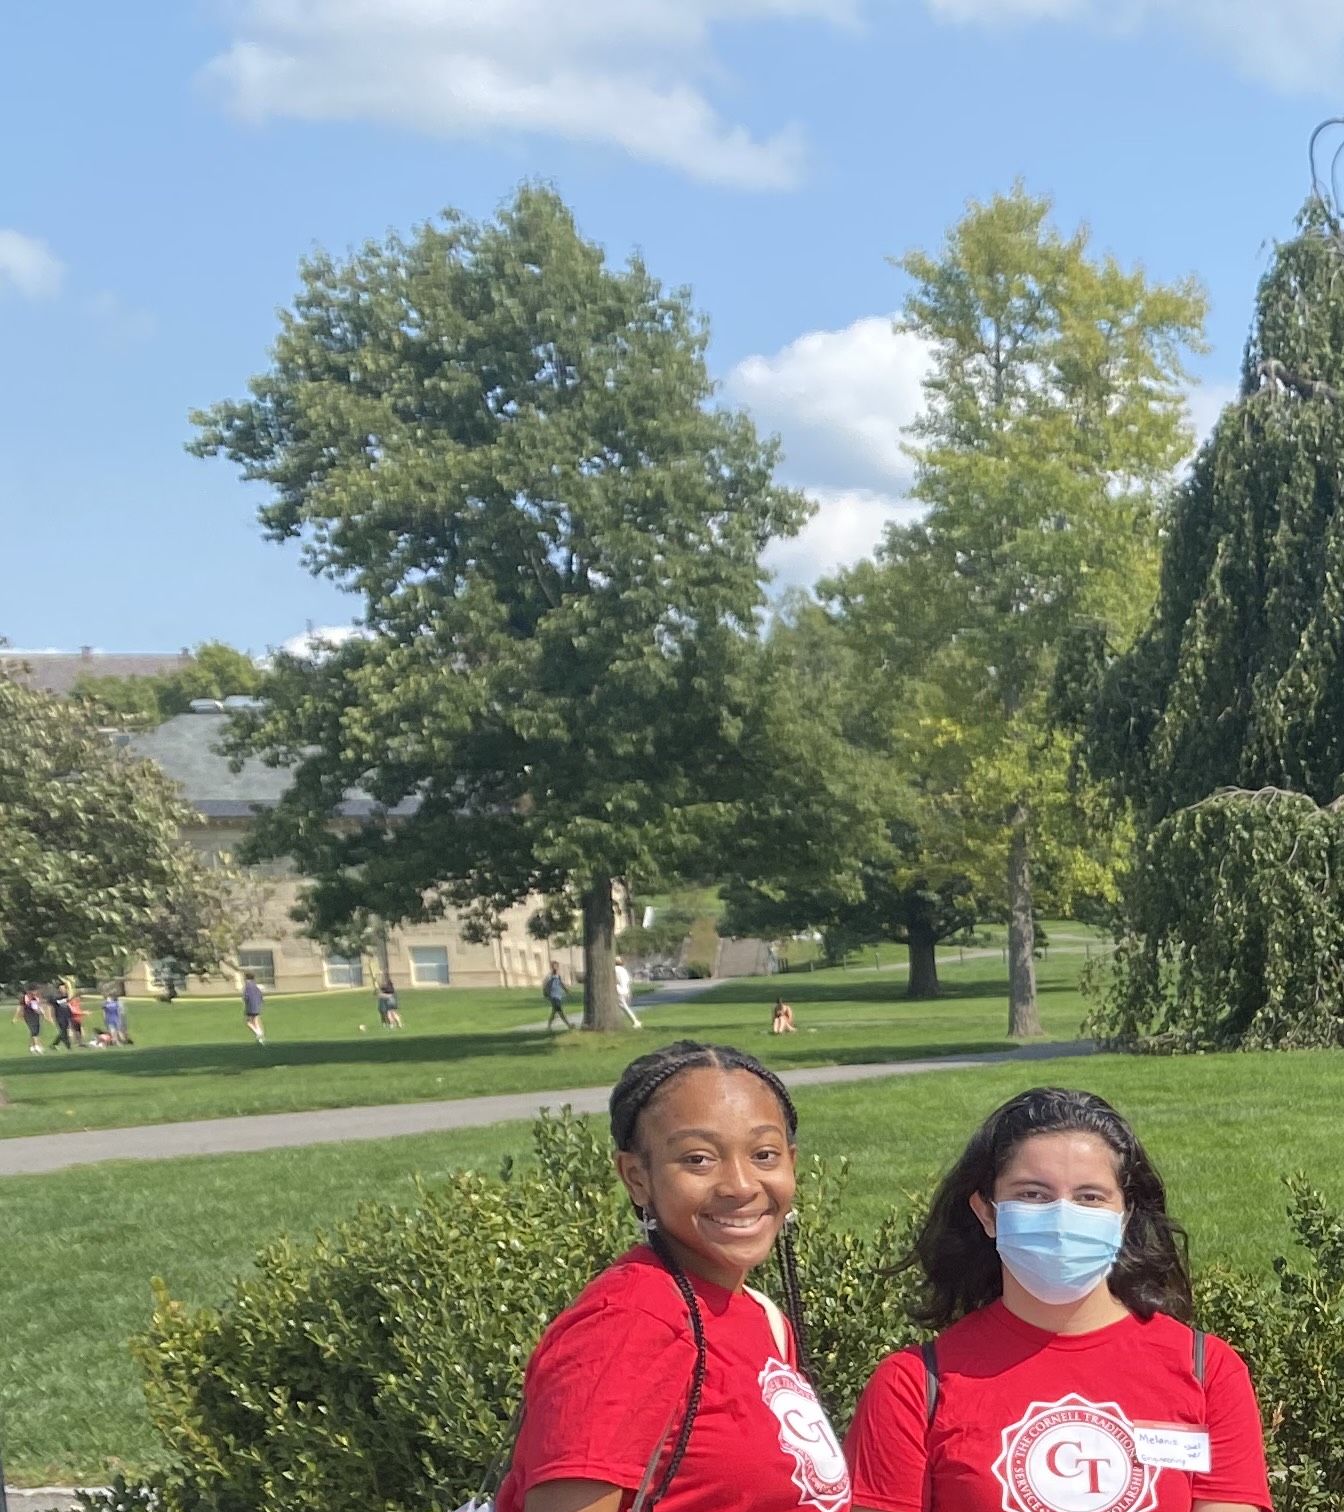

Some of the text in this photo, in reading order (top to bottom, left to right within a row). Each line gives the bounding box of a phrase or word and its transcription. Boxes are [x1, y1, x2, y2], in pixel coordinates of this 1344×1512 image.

[783, 1409, 838, 1458] CT
[1015, 1411, 1137, 1459] THE CORNELL TRADITION
[1013, 1466, 1041, 1512] SERVICE
[1045, 1440, 1111, 1494] CT
